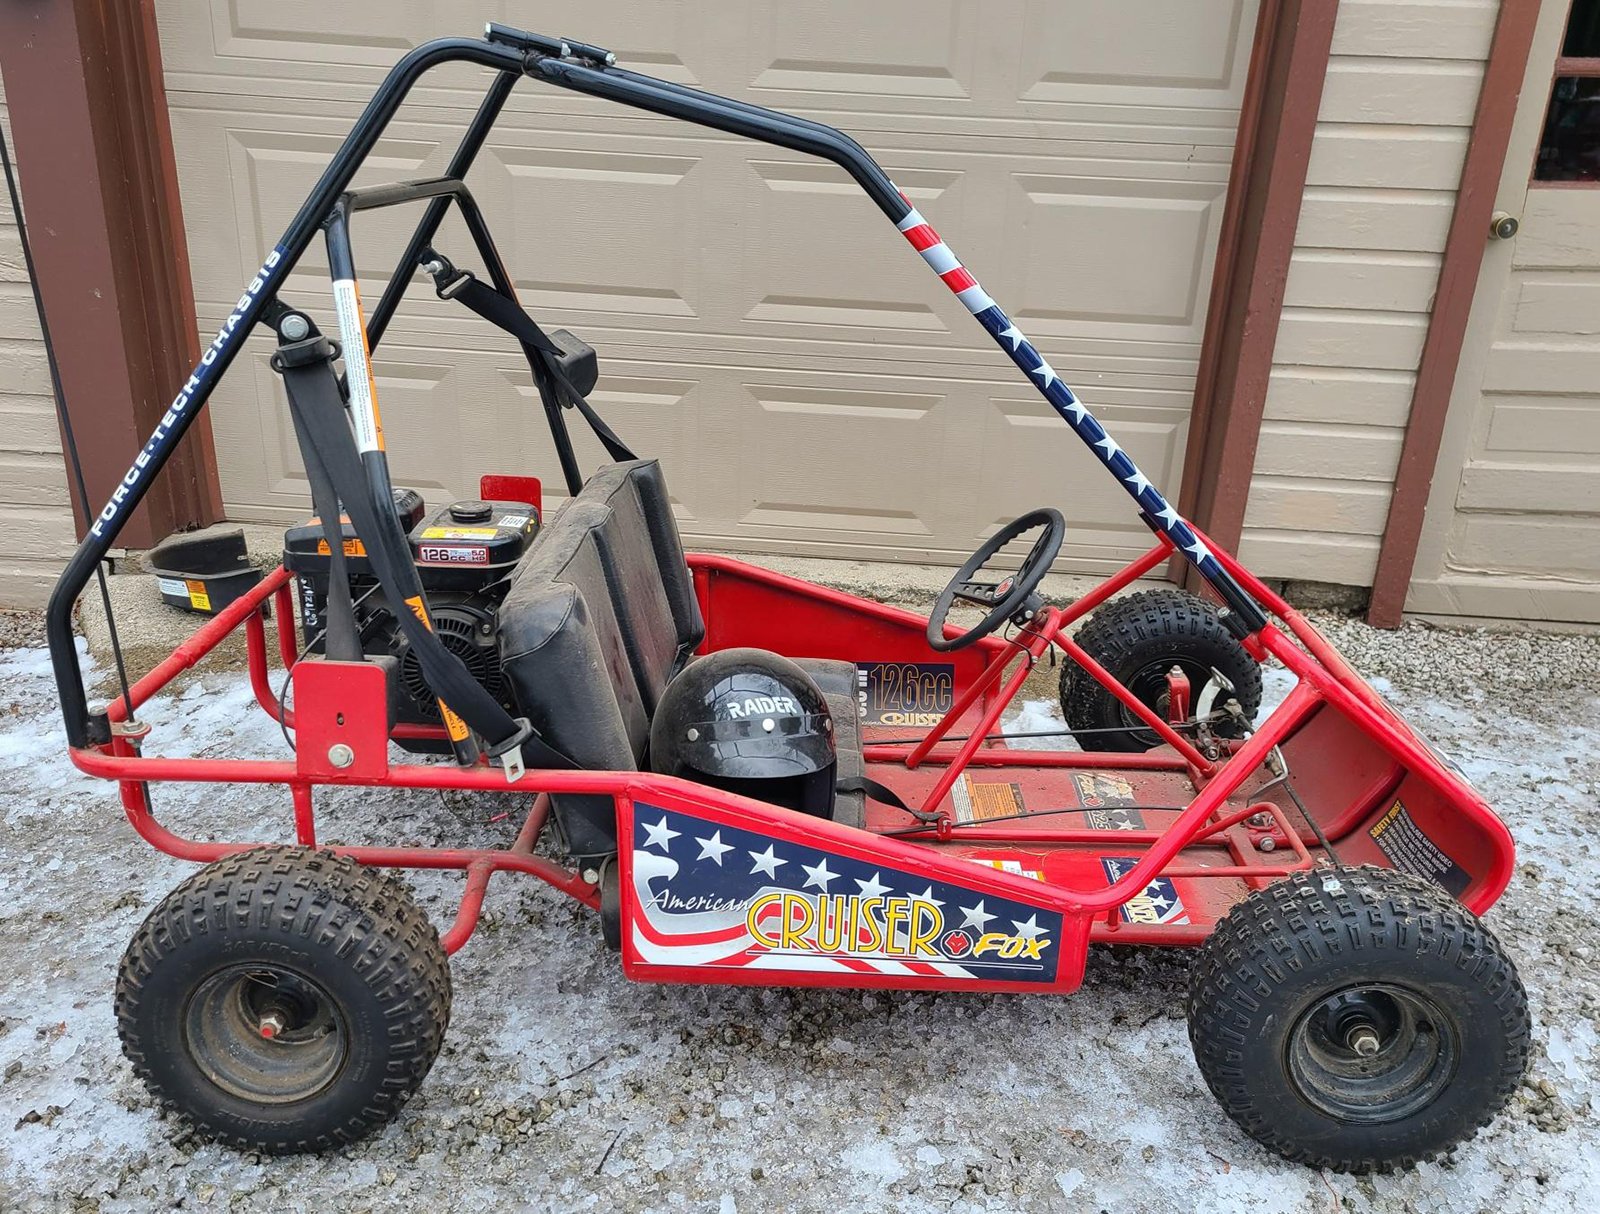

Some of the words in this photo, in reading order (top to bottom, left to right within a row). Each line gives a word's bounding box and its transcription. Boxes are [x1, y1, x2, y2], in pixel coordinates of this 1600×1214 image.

[201, 249, 281, 367] CHASSIS
[870, 663, 952, 712] 126cc
[726, 696, 798, 719] RAIDER
[1368, 813, 1391, 838] SAFETY
[1387, 799, 1400, 819] FIRST
[1376, 837, 1386, 848] FOR
[1420, 836, 1439, 855] SAFETY
[1436, 850, 1453, 867] VIDEO
[1411, 858, 1433, 881] CLOTHING
[1415, 850, 1437, 873] SECURELY
[645, 887, 751, 912] American
[744, 893, 945, 957] CRUISER
[973, 932, 1051, 961] FOX
